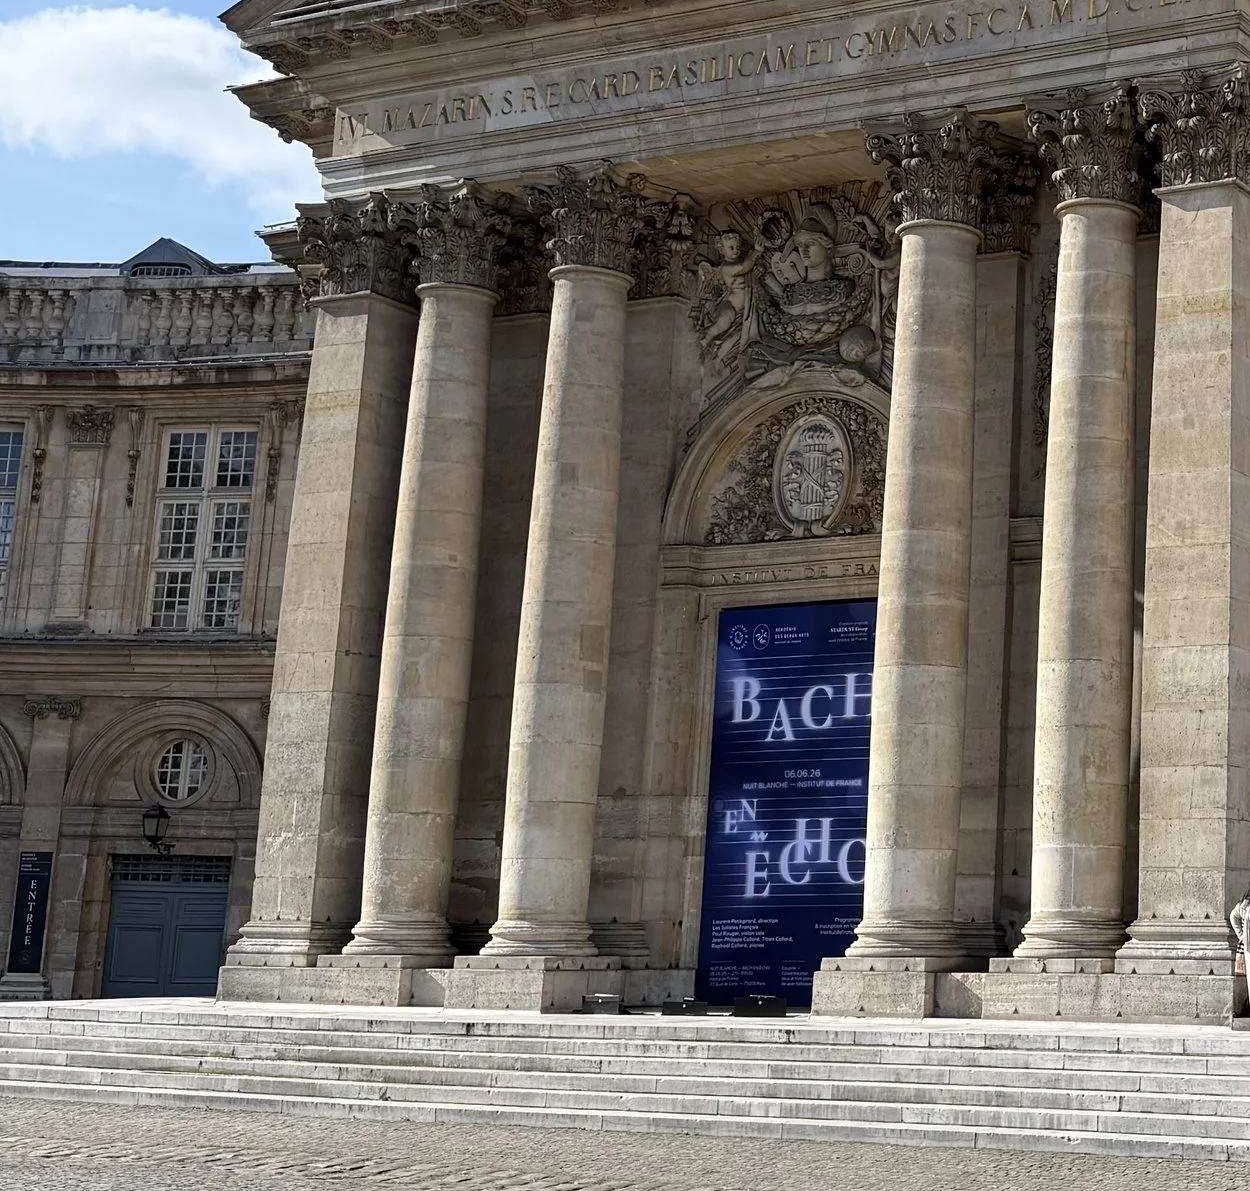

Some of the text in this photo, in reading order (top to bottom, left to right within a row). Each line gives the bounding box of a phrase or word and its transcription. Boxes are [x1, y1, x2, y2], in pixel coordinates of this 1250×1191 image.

[804, 566, 829, 579] DE
[841, 563, 878, 576] FRA
[784, 768, 821, 779] 06.06.26
[742, 782, 757, 790] NUIT
[758, 781, 789, 789] BLANCHE
[796, 780, 825, 788] INSTITUT
[825, 779, 835, 787] DE
[835, 778, 863, 787] FRANCE
[723, 798, 759, 834] EN
